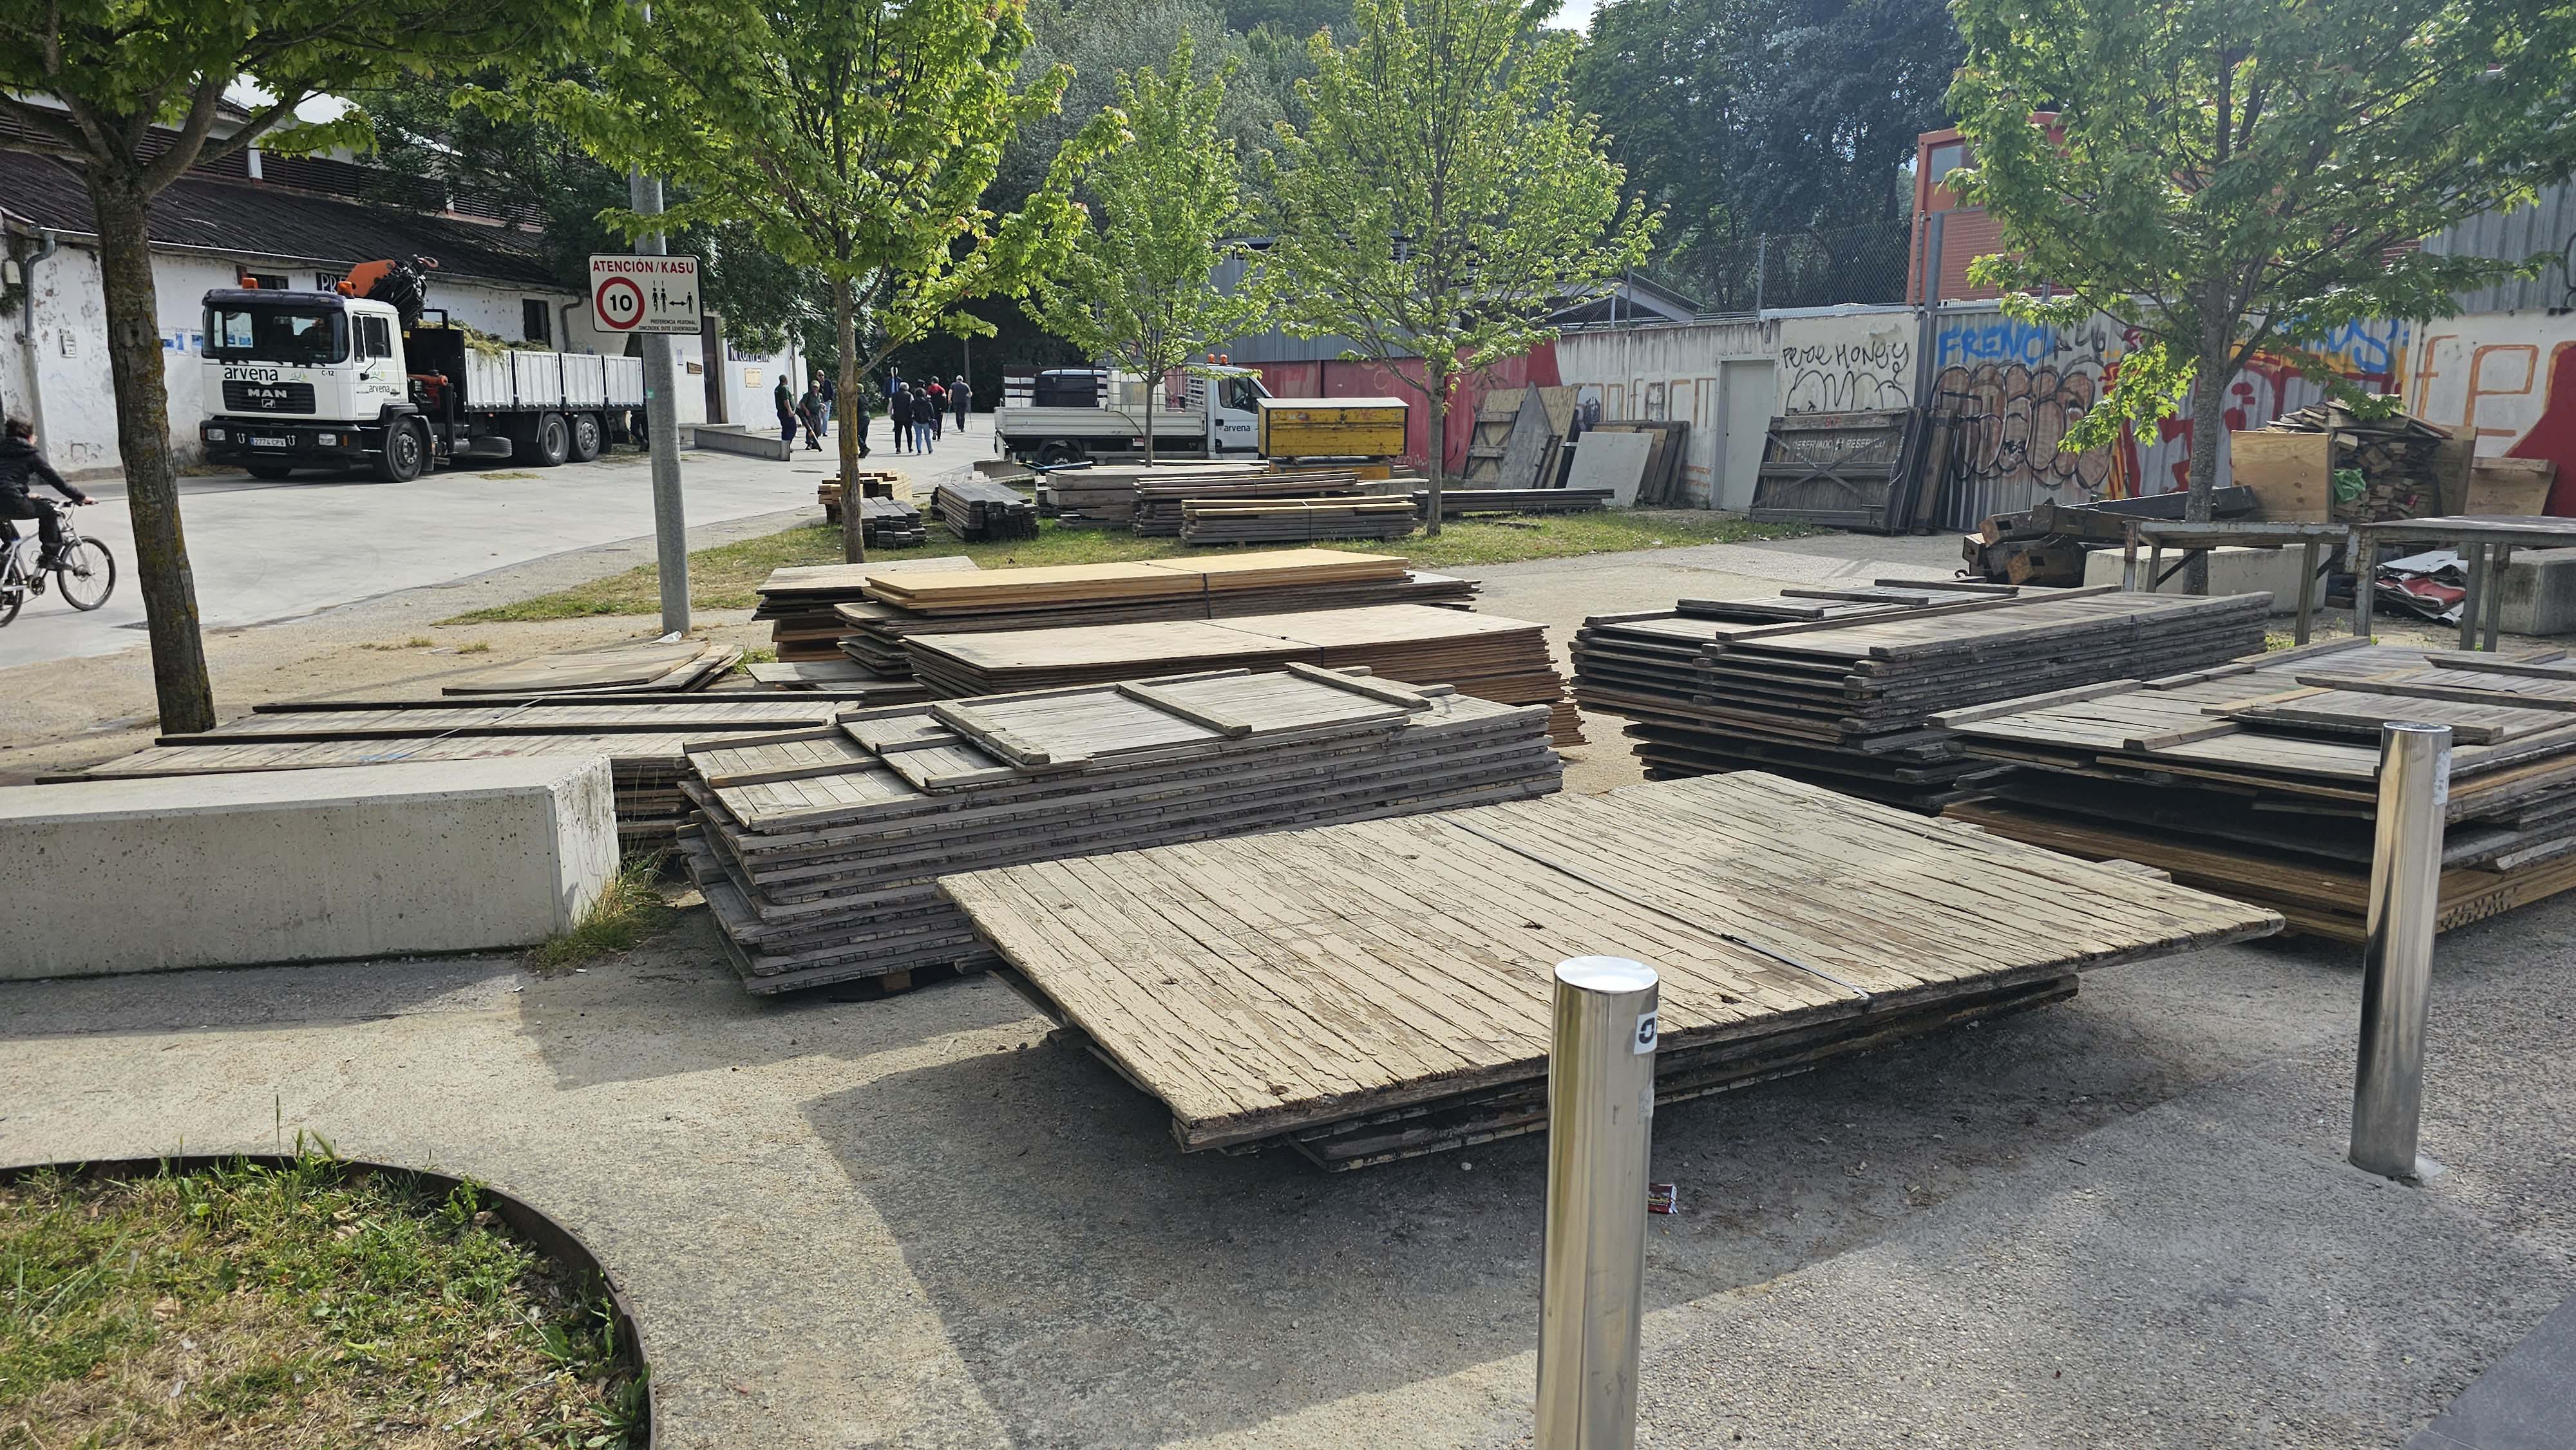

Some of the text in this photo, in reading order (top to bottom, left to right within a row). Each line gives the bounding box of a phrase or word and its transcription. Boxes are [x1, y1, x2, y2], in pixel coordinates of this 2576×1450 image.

[610, 294, 632, 312] 10
[225, 367, 278, 381] arvena
[248, 388, 287, 399] MAN
